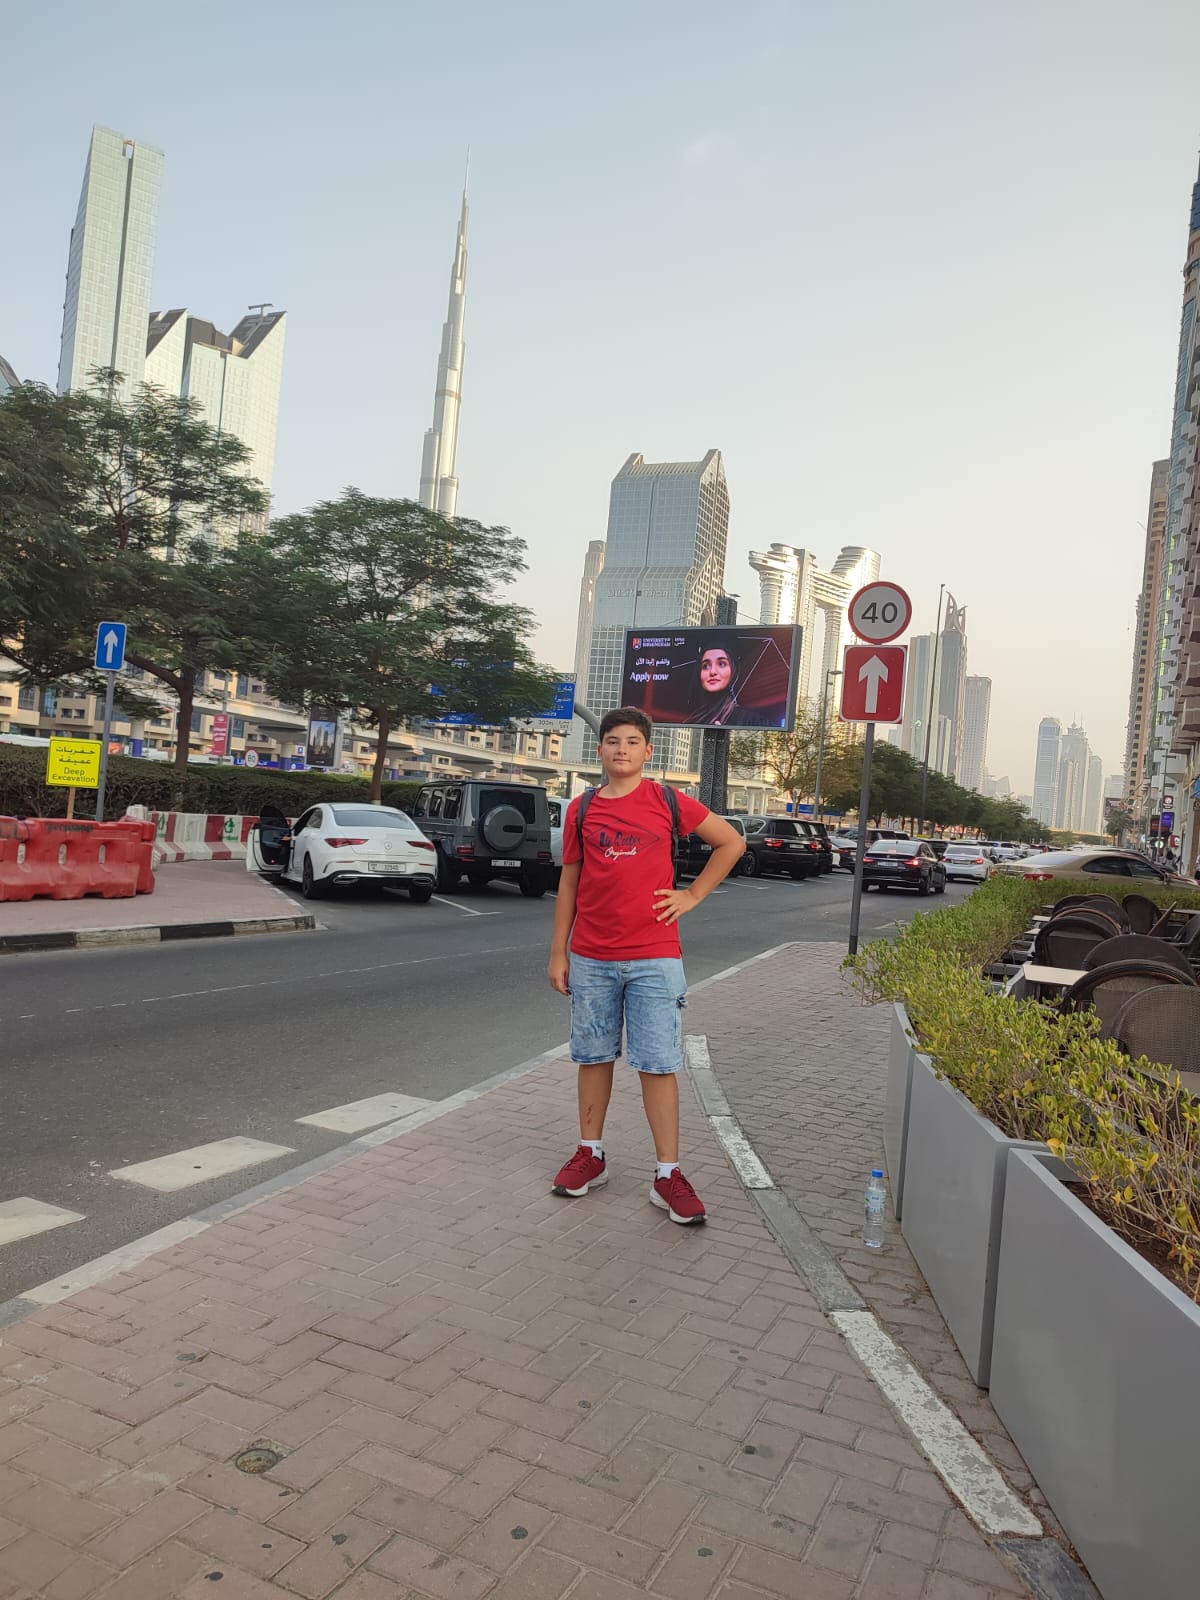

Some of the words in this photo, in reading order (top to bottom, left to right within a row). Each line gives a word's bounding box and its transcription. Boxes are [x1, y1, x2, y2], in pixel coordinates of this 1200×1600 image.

[861, 602, 898, 624] 40
[629, 671, 651, 683] Apply
[652, 673, 670, 681] now
[56, 746, 96, 755] حفريات
[58, 755, 92, 766] عميقة
[64, 767, 86, 777] Deep
[52, 773, 96, 784] Excavation
